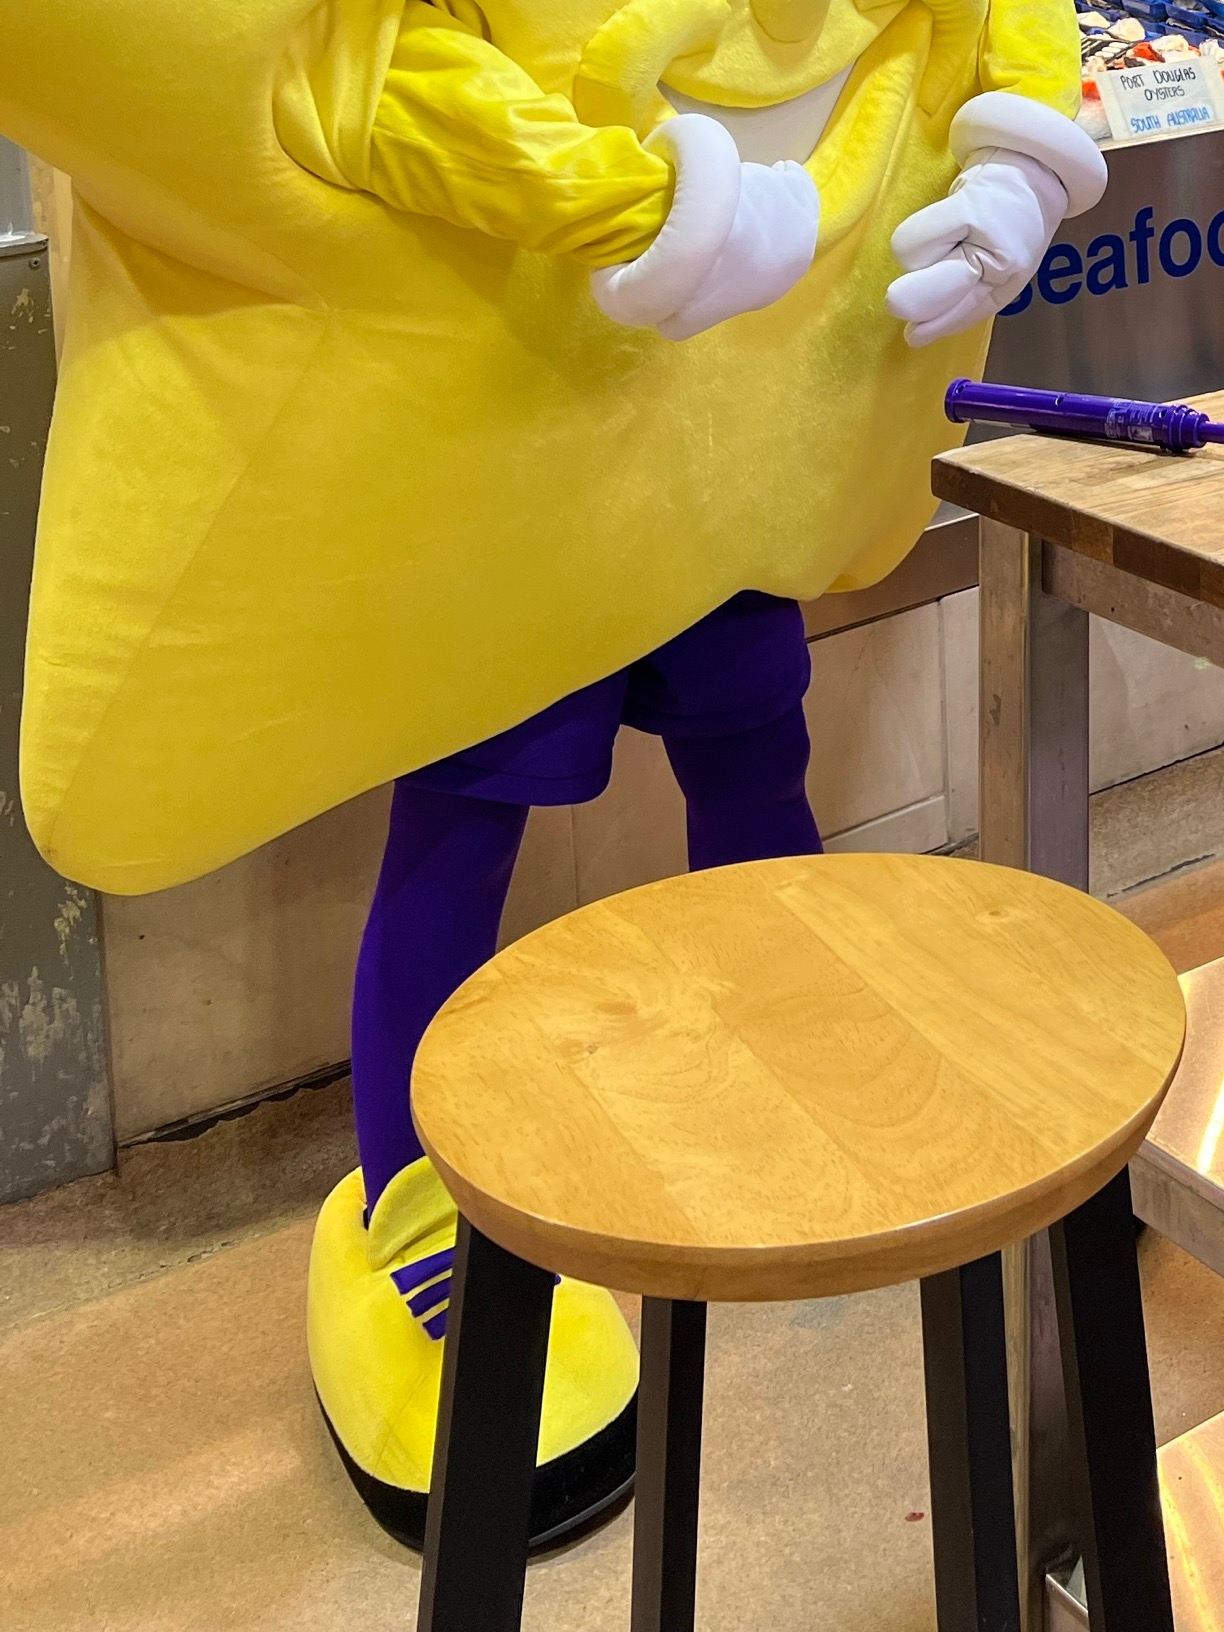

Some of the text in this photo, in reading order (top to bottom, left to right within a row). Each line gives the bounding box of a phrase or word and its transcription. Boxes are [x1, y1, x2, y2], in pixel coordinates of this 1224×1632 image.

[1120, 66, 1197, 90] PORT DOUGLAS
[1144, 85, 1185, 101] OYSTERS
[1130, 106, 1211, 134] SOUTH AUSTRALIA
